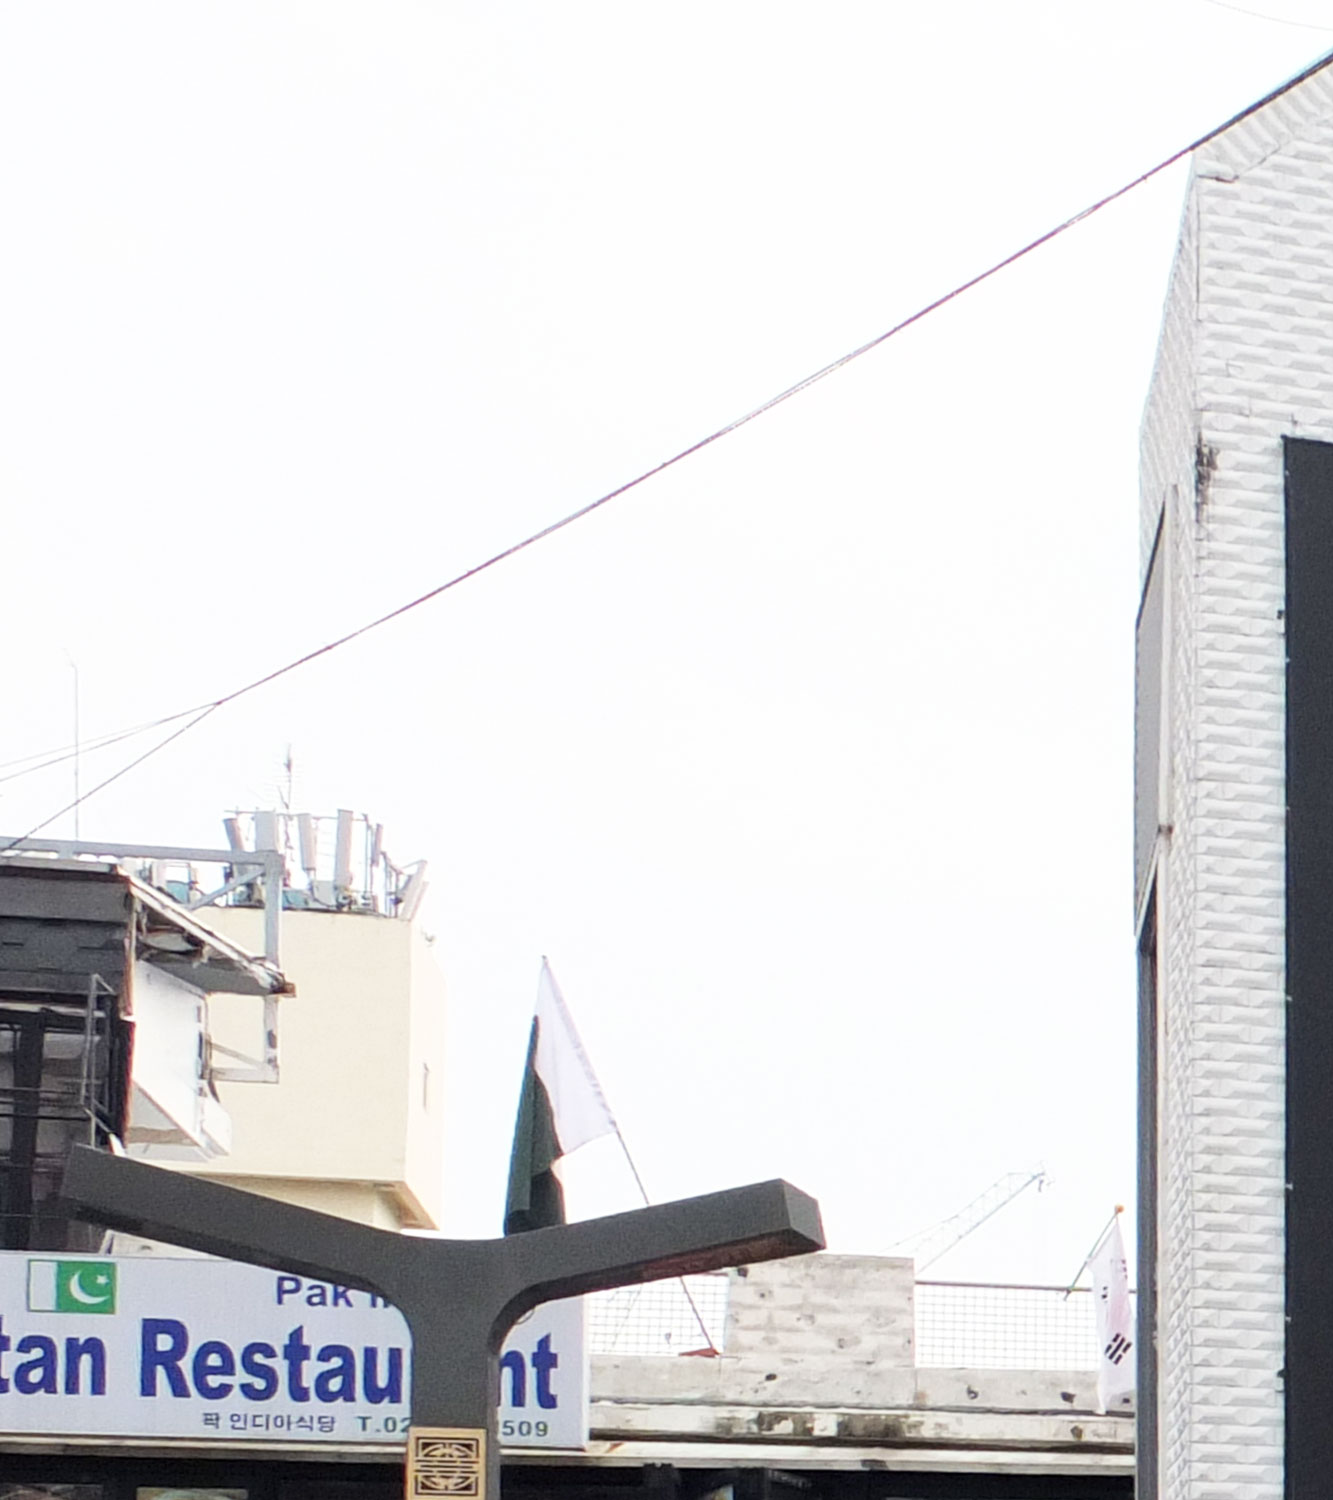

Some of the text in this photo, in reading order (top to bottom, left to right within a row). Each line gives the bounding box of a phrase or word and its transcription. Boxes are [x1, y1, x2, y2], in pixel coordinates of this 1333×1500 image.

[277, 1276, 353, 1308] Pak
[141, 1318, 558, 1409] Restaunt
[229, 1413, 336, 1432] 인디아식당
